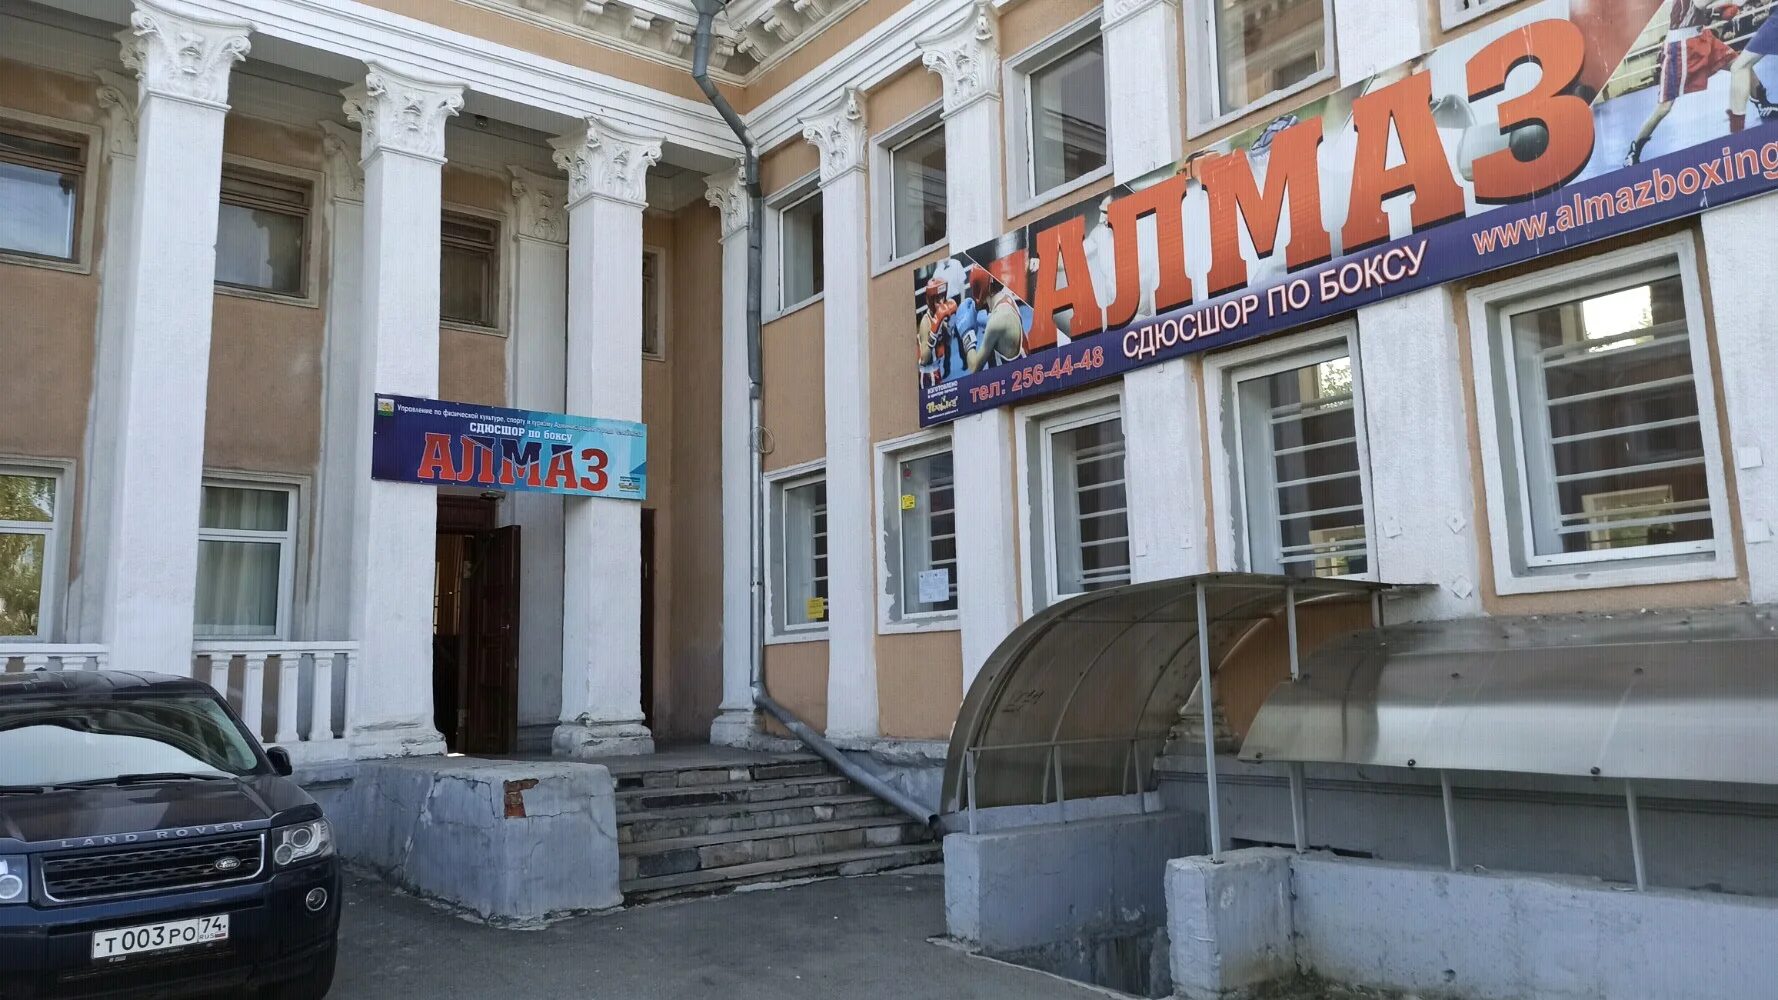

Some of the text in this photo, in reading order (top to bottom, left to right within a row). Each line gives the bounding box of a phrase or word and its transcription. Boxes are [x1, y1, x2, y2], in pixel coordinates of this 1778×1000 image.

[1028, 18, 1596, 354] АЛМАЗ
[1472, 141, 1778, 256] www.almazboxing
[1122, 239, 1428, 360] СДЮСШОР ПО БОКСУ
[970, 346, 1105, 404] тел: 256-44-48
[417, 432, 609, 492] АЛМАЗ
[469, 422, 573, 443] СДЮСШОР по боксу
[61, 822, 244, 848] LAND ROVER
[201, 917, 221, 933] 74
